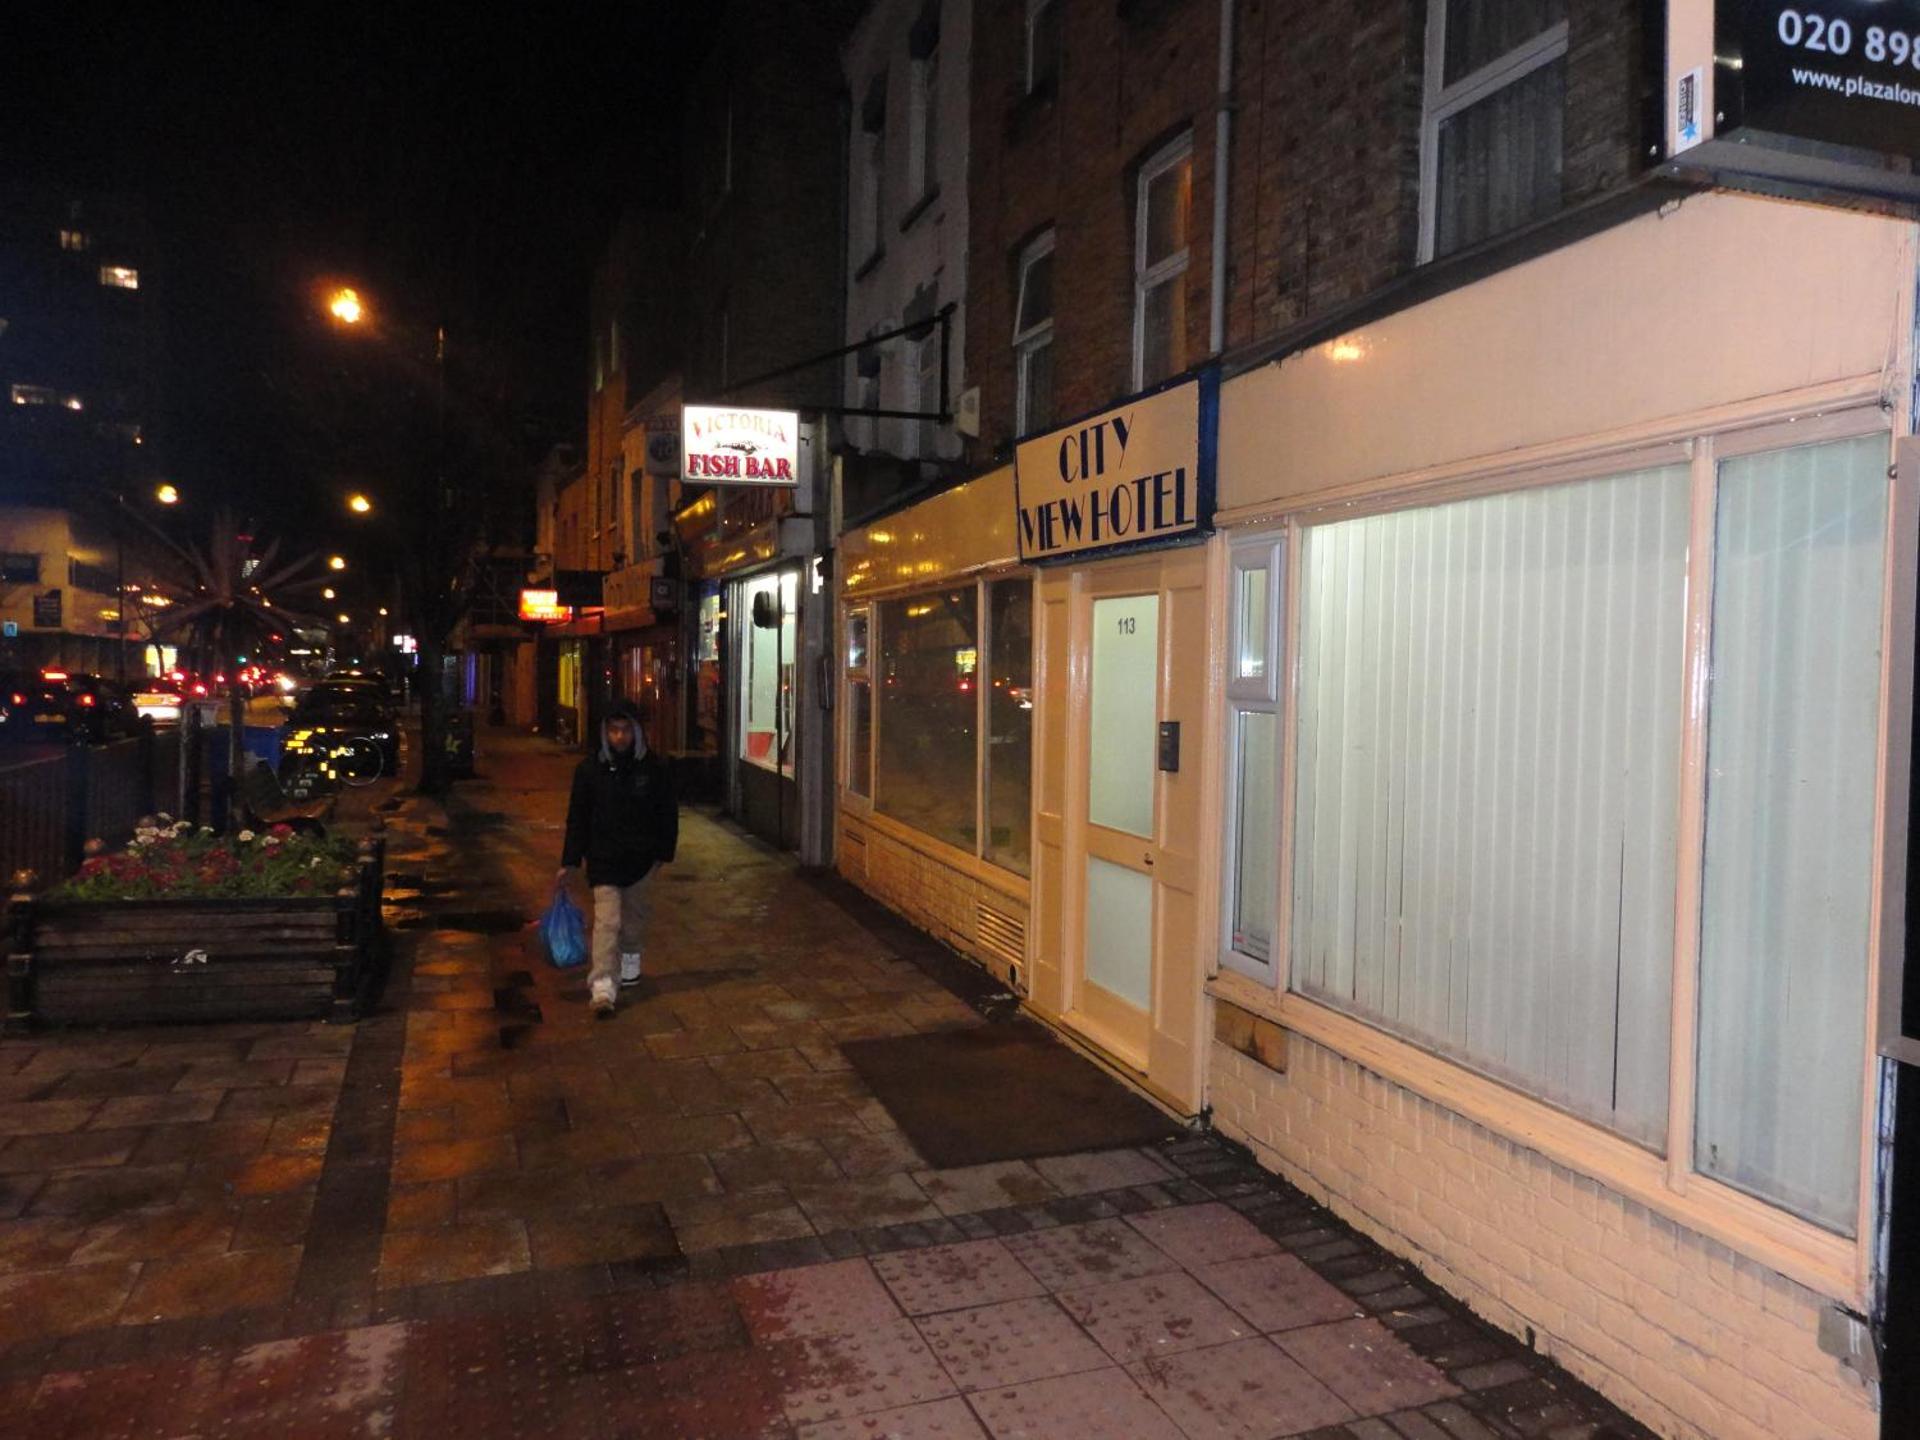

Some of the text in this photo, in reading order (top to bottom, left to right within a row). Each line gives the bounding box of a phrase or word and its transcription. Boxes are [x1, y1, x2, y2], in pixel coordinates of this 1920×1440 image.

[1778, 9, 1851, 55] 020
[691, 413, 787, 443] VICTORIA
[1059, 412, 1134, 484] CITY
[688, 454, 793, 481] FISH BAR
[1021, 467, 1195, 551] VIEW HOTEL
[1118, 616, 1136, 635] 113
